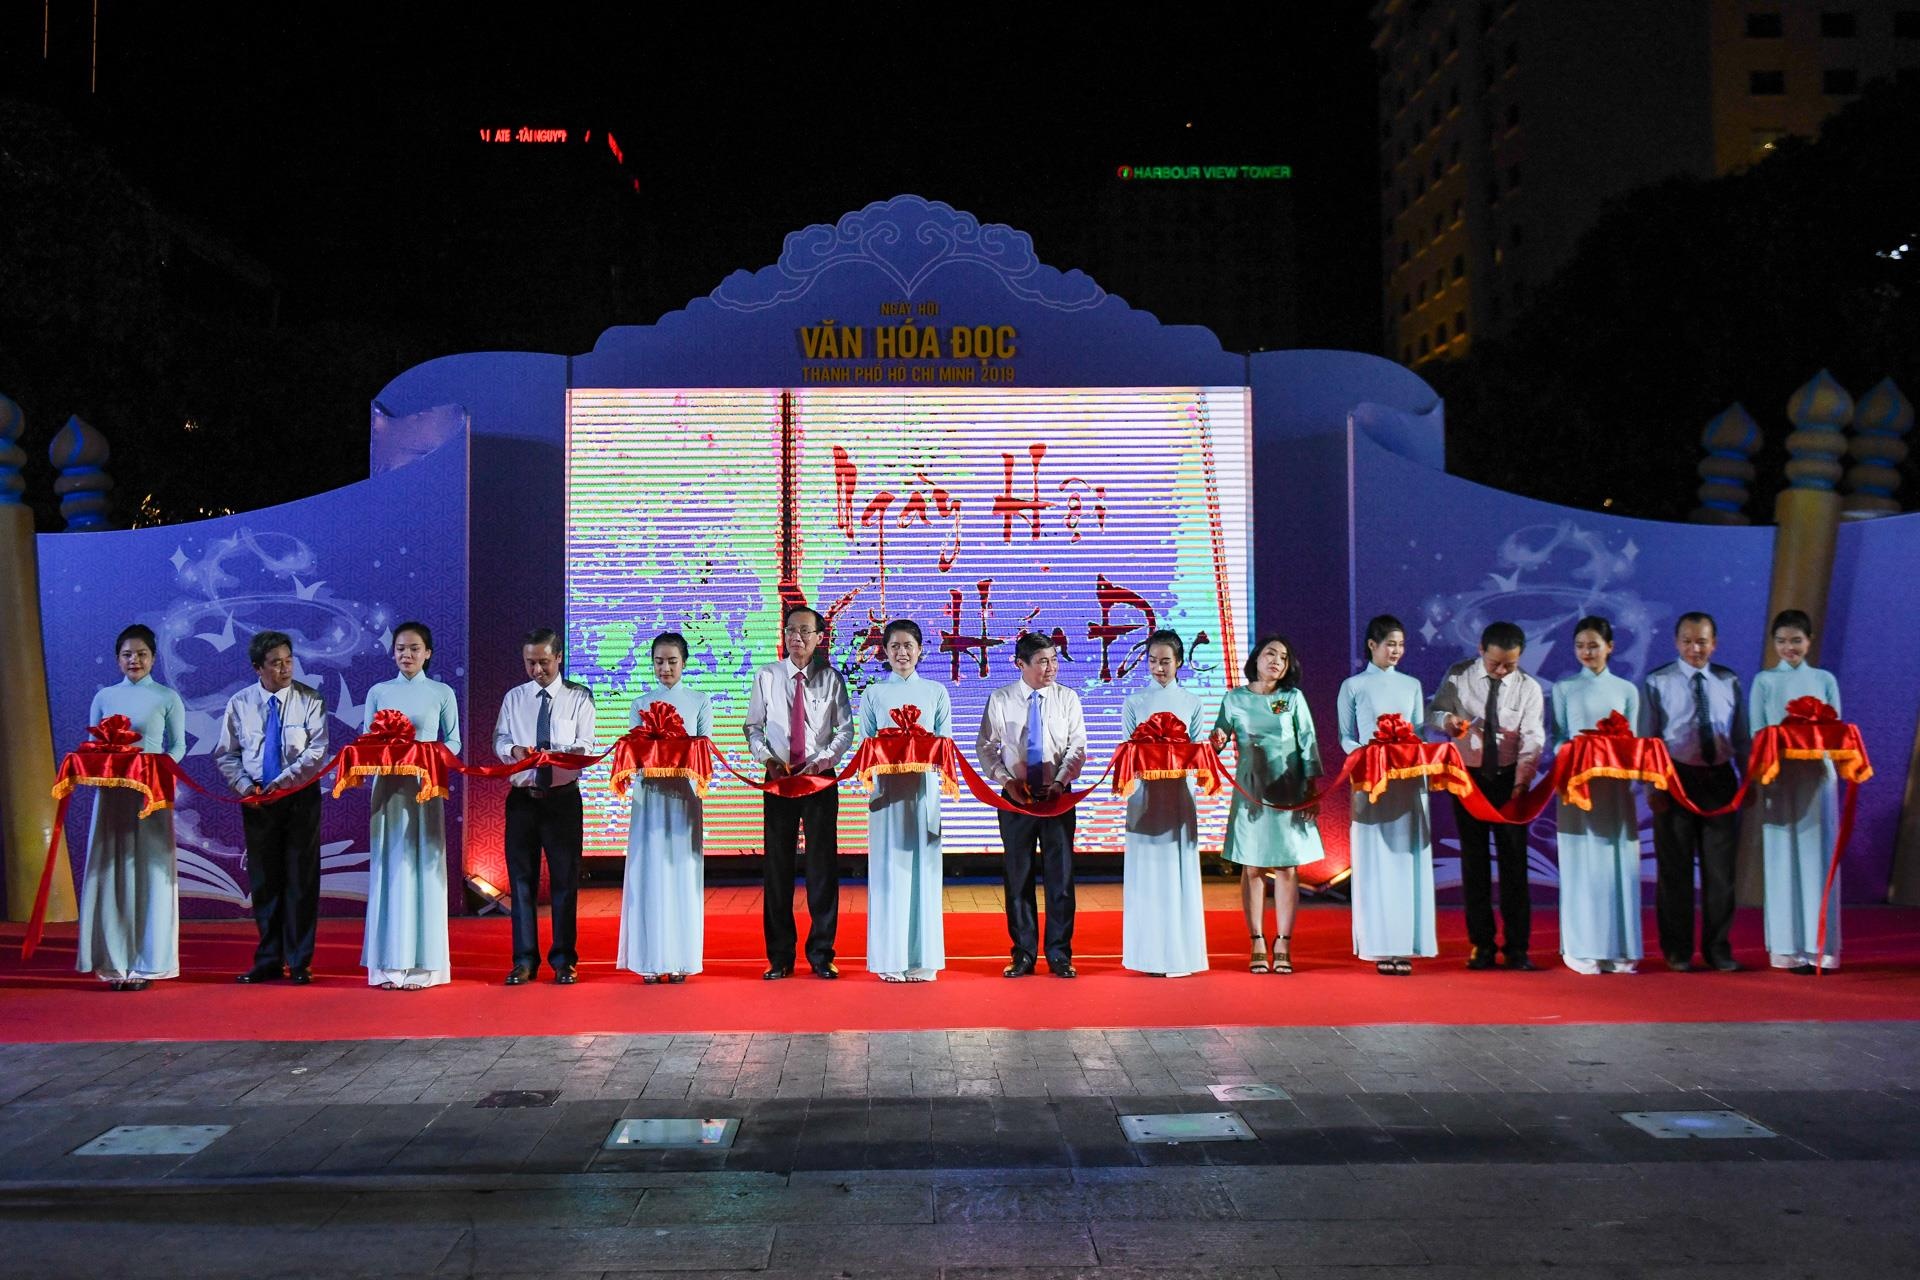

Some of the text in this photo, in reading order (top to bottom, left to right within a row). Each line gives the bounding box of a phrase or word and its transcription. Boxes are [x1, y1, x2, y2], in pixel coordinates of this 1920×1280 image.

[1134, 166, 1292, 179] HARBOUR VIEW TOWER
[800, 317, 1017, 366] VĂN HÓA ĐỌC
[939, 366, 976, 382] MINH
[981, 366, 1016, 383] 2019
